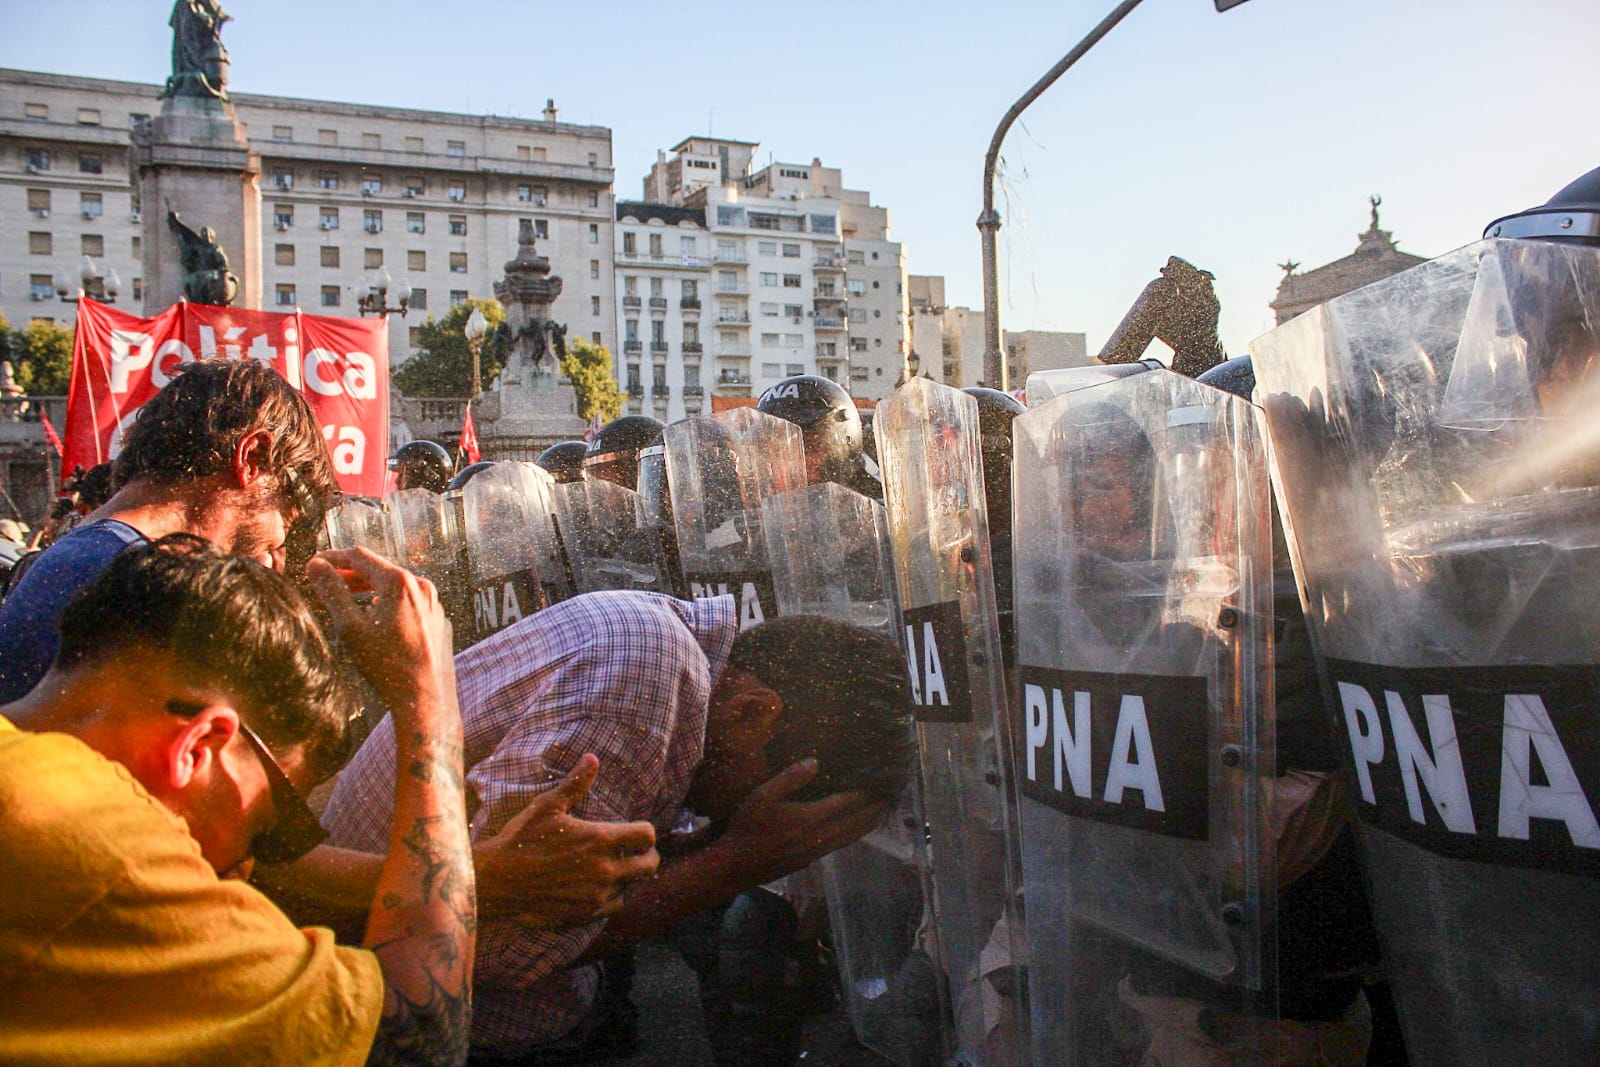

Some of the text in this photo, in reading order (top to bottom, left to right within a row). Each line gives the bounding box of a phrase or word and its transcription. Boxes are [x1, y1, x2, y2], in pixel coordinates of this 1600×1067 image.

[474, 581, 524, 634] PNA
[1025, 683, 1166, 812] PNA
[1338, 681, 1600, 849] PNA
